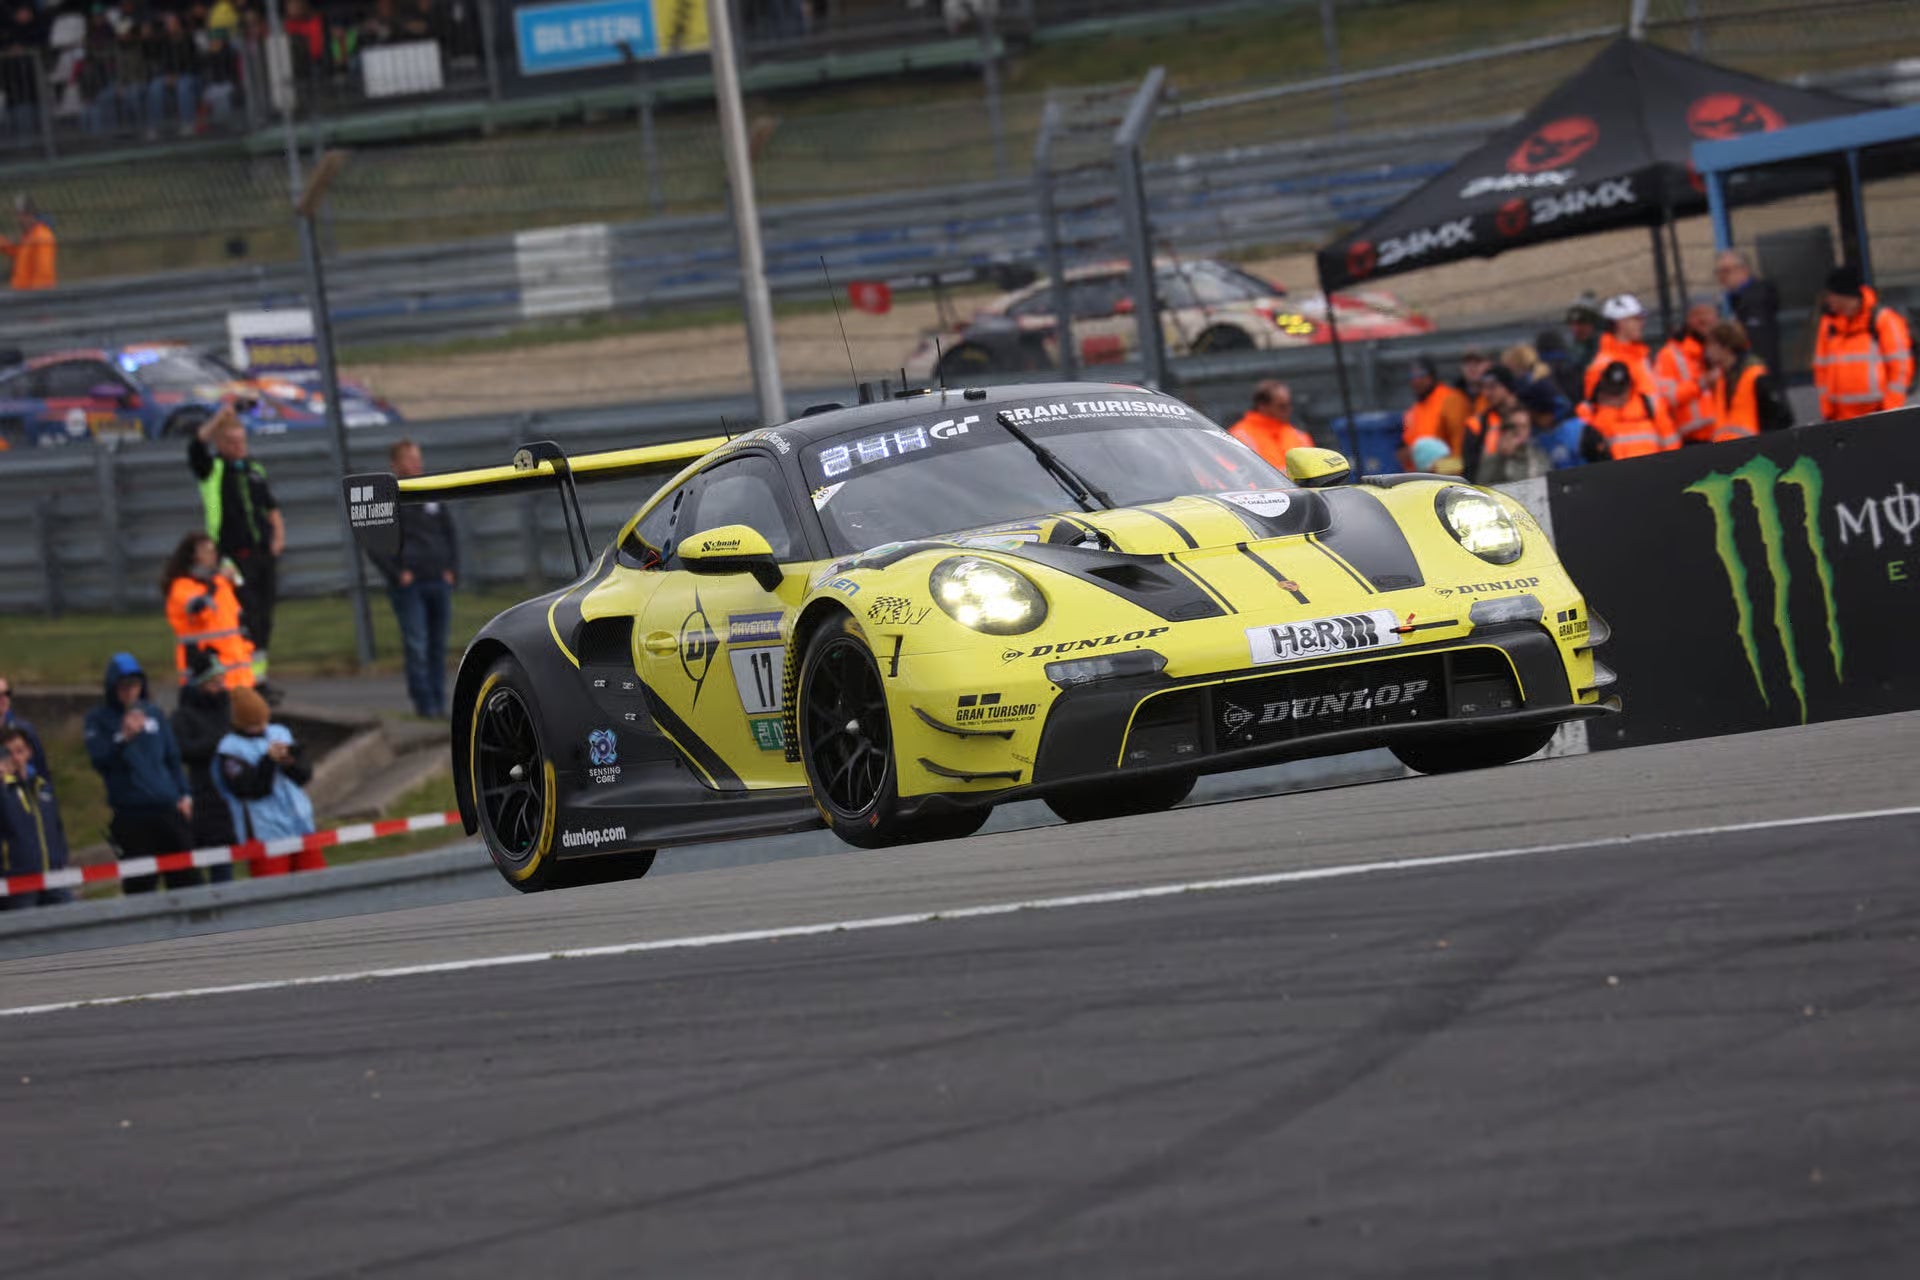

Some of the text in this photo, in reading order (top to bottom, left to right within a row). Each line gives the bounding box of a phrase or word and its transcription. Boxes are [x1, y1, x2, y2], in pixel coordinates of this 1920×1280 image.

[533, 15, 642, 54] BILSTEIN
[1531, 177, 1636, 225] 24MX
[1377, 216, 1475, 268] 24MX
[1000, 400, 1186, 422] GRAN TURISMO
[820, 427, 927, 477] 24H
[351, 504, 367, 520] GRAN
[1456, 576, 1540, 595] DUNLOP
[1027, 627, 1169, 658] DUNLOP
[1270, 620, 1343, 658] H&R
[751, 652, 776, 708] 17
[956, 703, 1036, 721] GRAN TURISMO
[1258, 680, 1429, 724] DUNLOP
[589, 766, 621, 777] SENSING
[595, 774, 616, 784] CORE
[562, 826, 627, 848] dunlop.com
